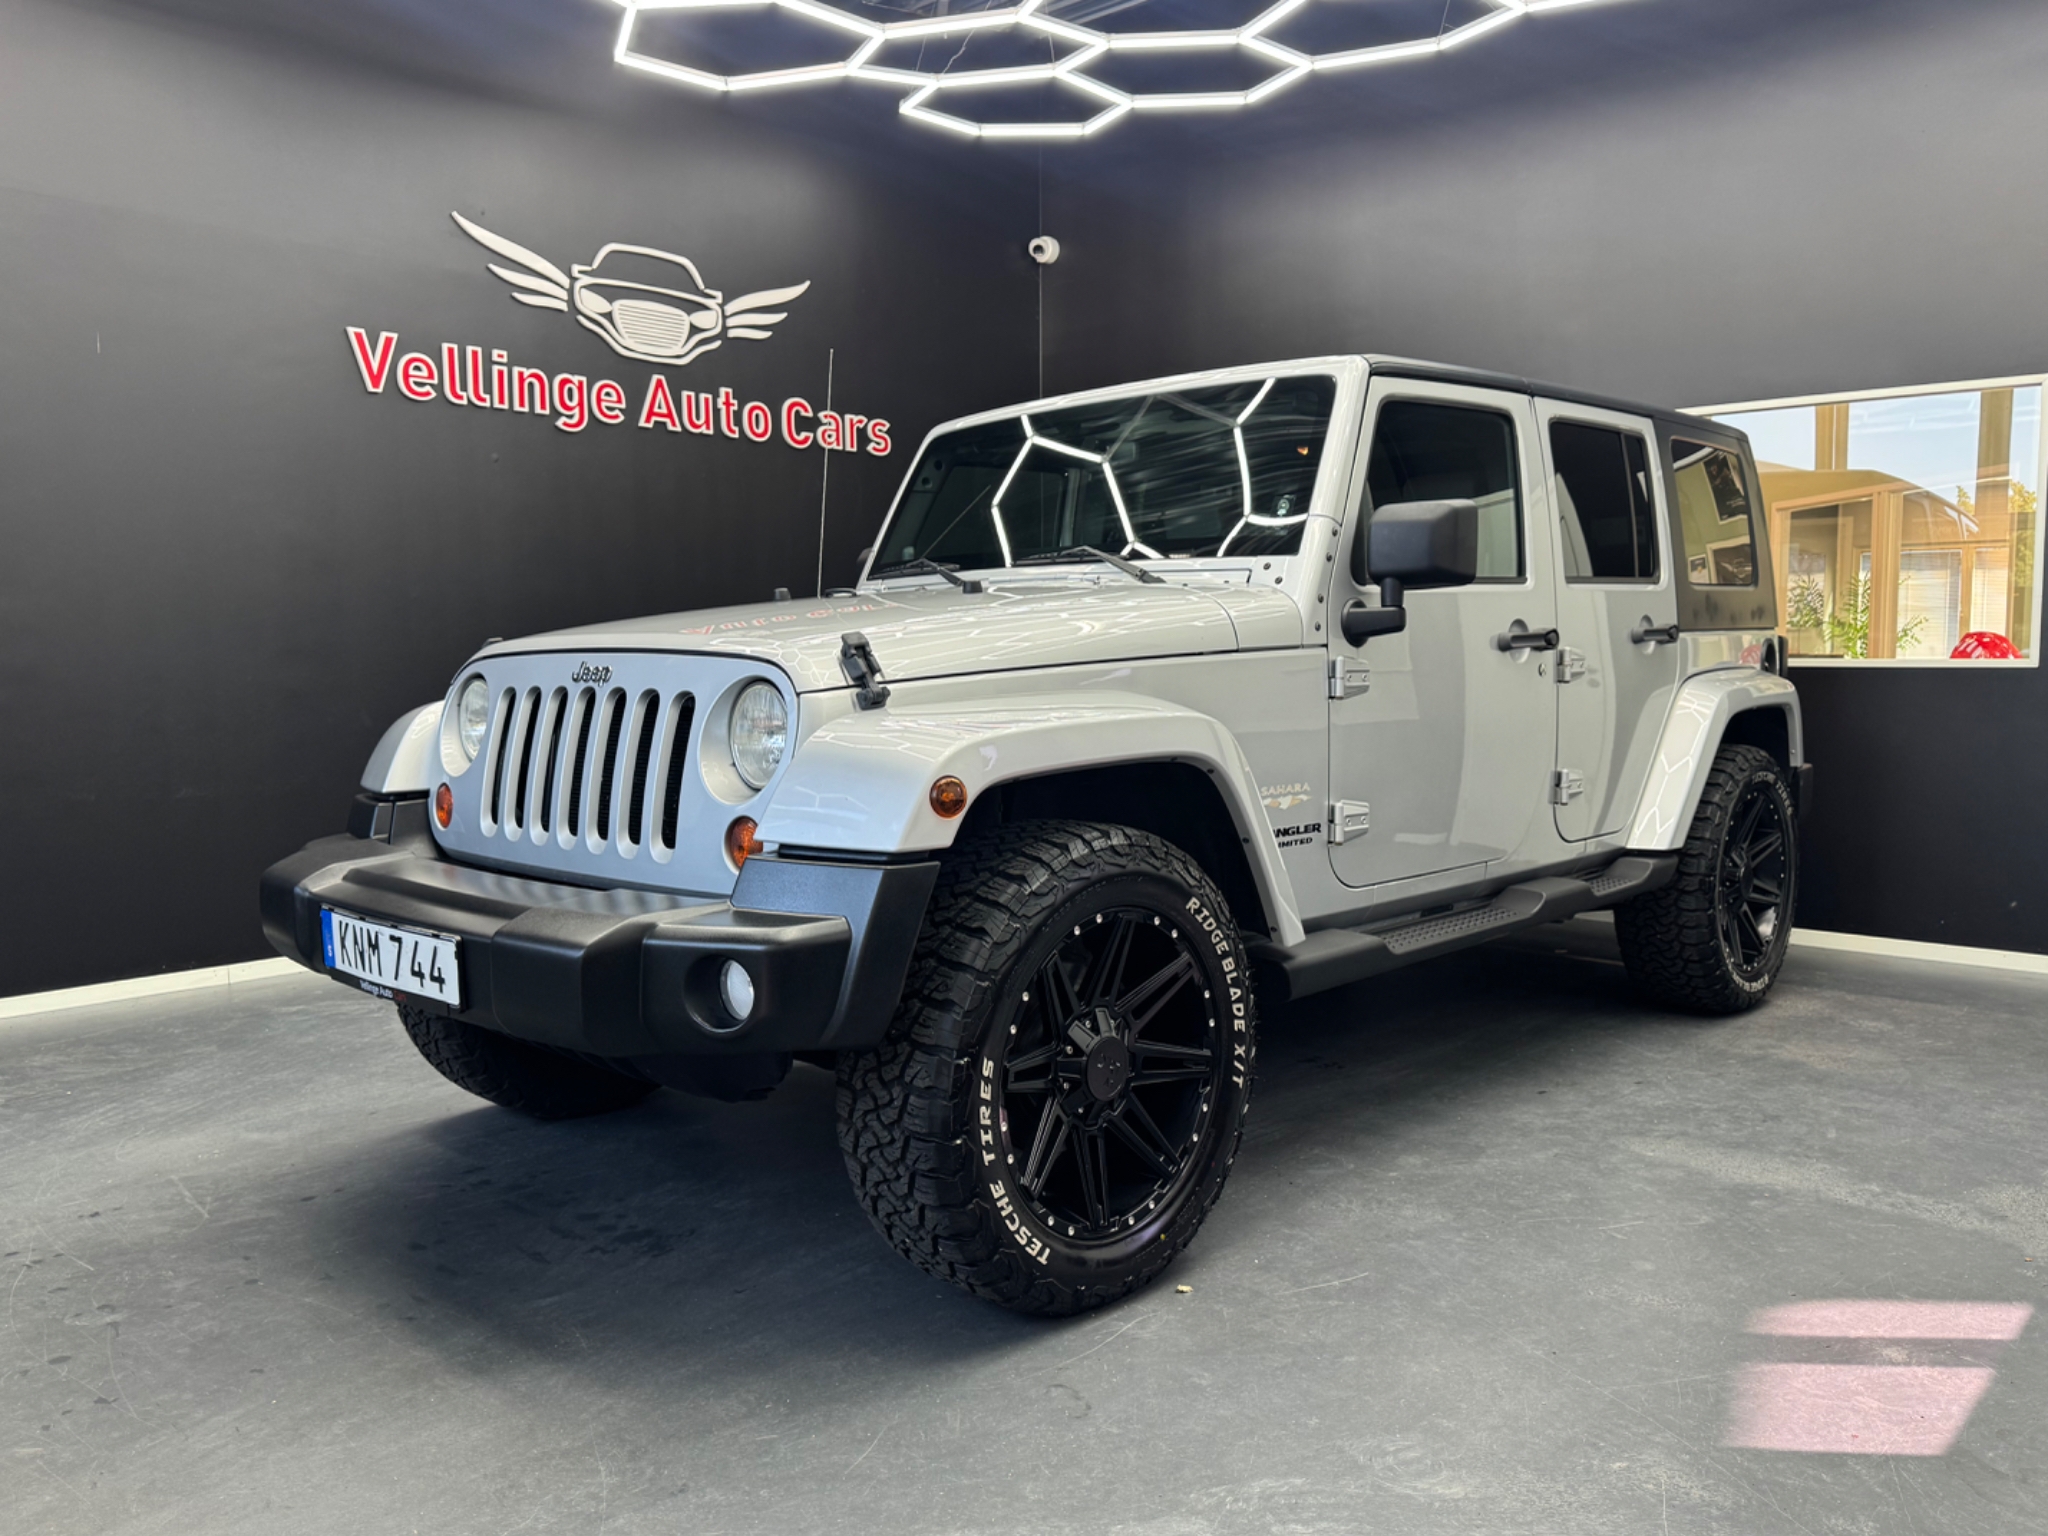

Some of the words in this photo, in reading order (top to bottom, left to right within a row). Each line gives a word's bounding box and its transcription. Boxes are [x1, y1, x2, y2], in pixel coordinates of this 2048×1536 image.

[346, 326, 626, 431] Vellinge
[638, 374, 773, 441] Auto
[781, 397, 892, 456] Cars
[572, 661, 613, 687] Jeep
[1260, 782, 1311, 797] SAHARA
[1272, 822, 1322, 838] NGLER
[1278, 836, 1313, 849] IMITED
[339, 919, 383, 978] KNM
[389, 934, 446, 994] 744
[1232, 1043, 1246, 1089] X/T
[979, 1056, 995, 1167] TIRES
[989, 1179, 1051, 1266] TESCHE
